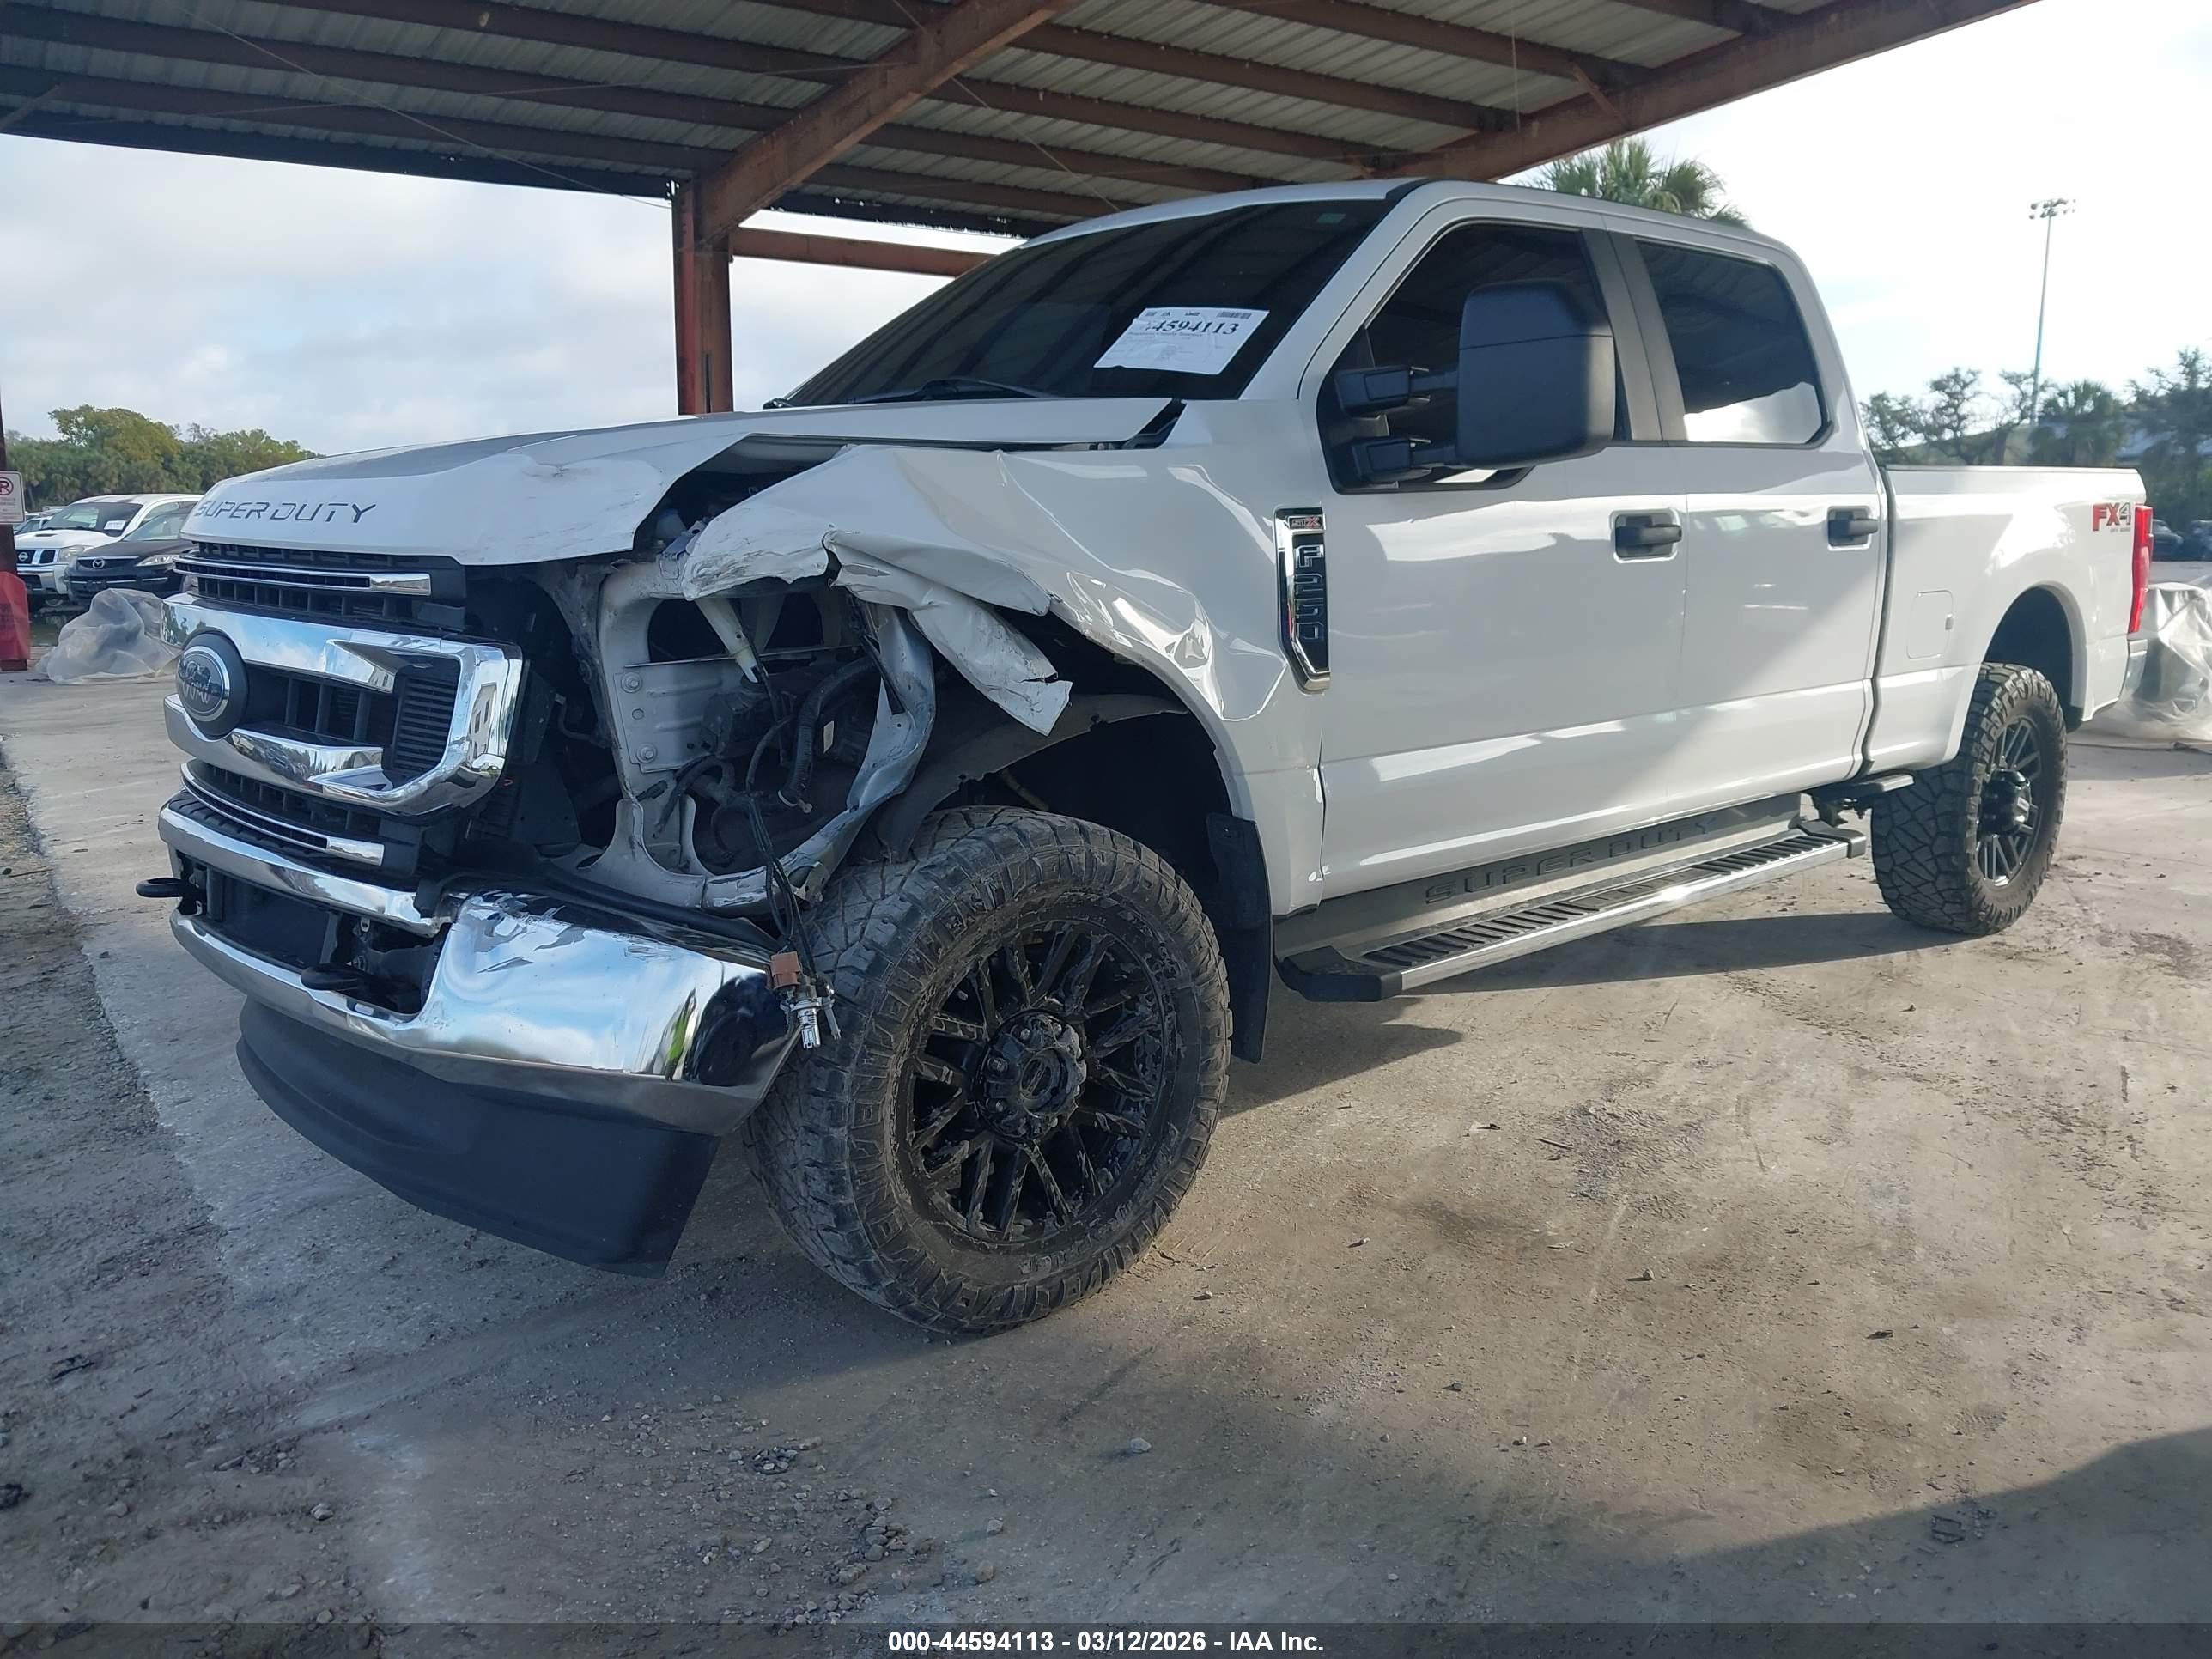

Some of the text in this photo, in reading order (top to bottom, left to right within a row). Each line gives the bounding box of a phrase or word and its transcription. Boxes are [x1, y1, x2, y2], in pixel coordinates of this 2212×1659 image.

[1146, 320, 1239, 335] 4594113
[194, 501, 377, 523] SUPER DUTY
[2093, 502, 2131, 532] FX4
[1425, 817, 1717, 904] SUPER DUTY
